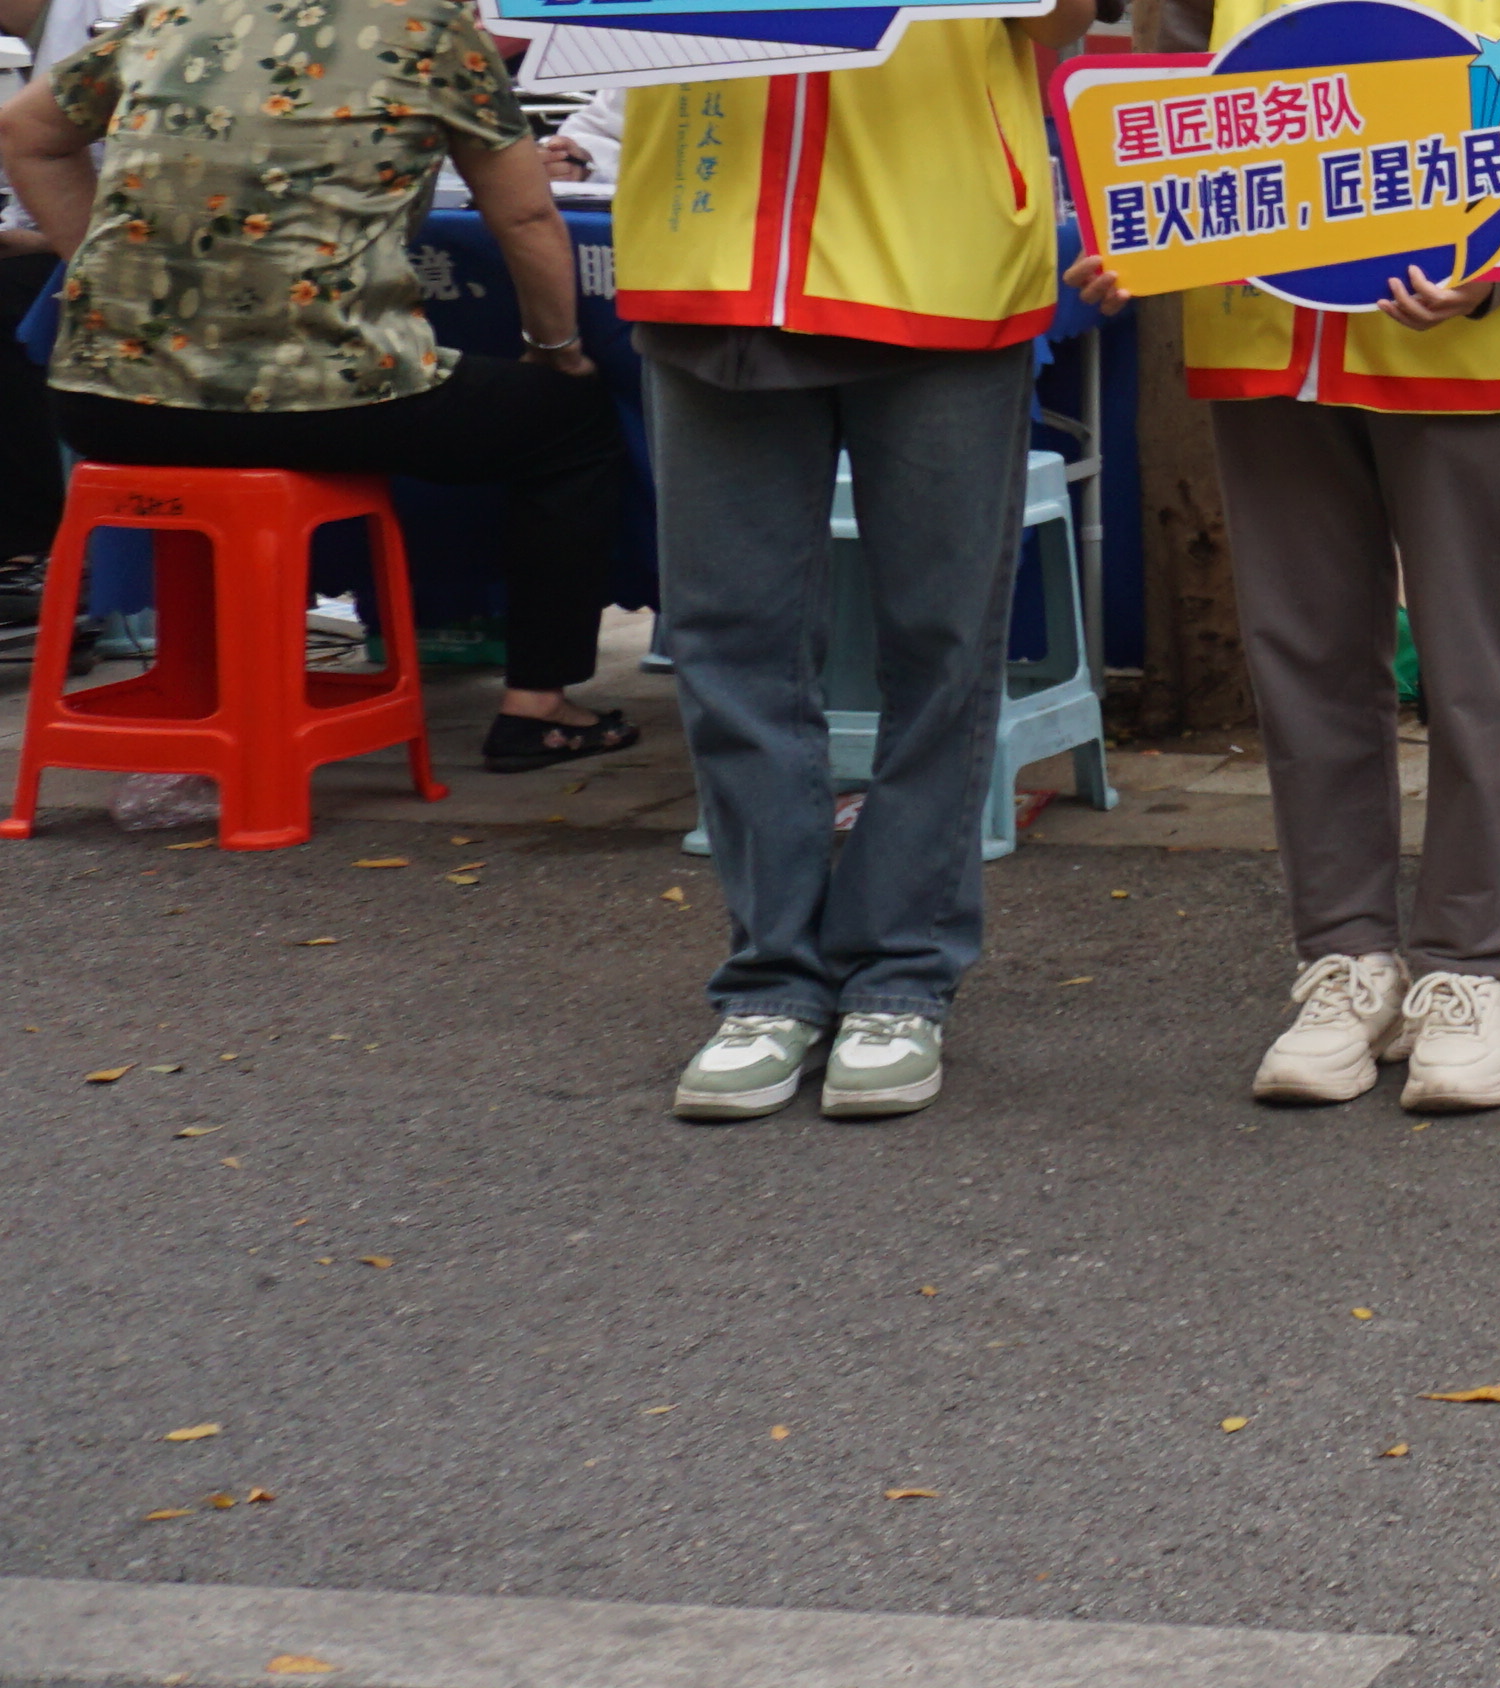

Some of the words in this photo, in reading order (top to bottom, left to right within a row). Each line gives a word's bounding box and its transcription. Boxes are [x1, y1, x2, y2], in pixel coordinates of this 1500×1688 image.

[1115, 74, 1362, 165] 星匠服务队
